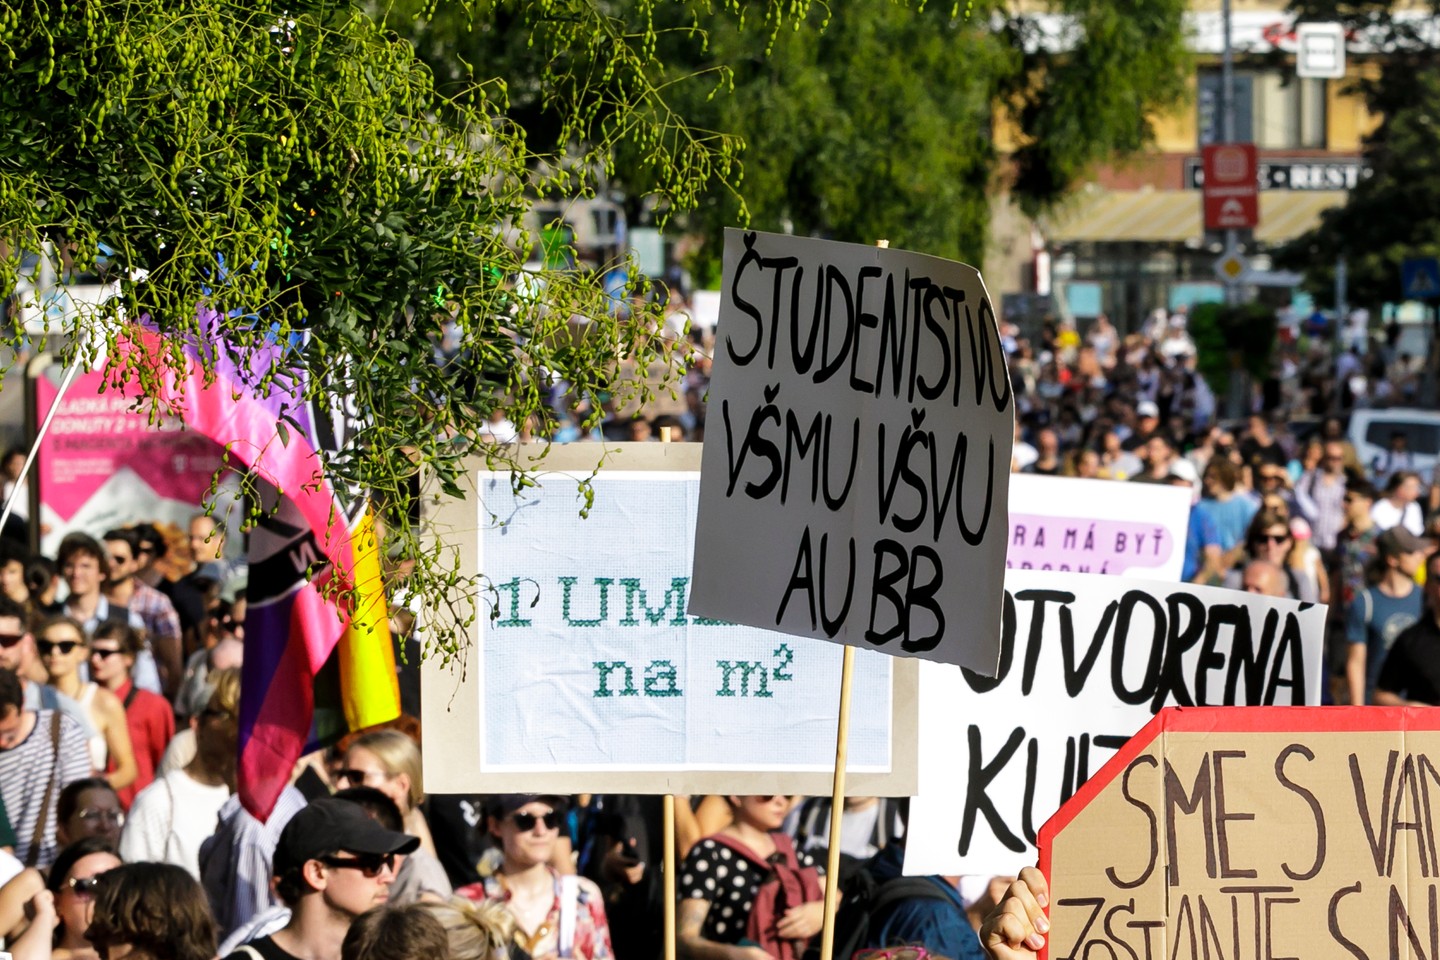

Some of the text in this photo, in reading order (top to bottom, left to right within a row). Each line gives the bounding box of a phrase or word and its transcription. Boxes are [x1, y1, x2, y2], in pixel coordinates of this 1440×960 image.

[725, 231, 1010, 413] ŠTUDENTSTVO
[722, 383, 995, 546] VŠMU VŠVU
[558, 576, 740, 628] UM
[775, 525, 946, 653] AU BB
[1013, 523, 1164, 556] RA MÁ BYŤ
[593, 660, 684, 698] na
[1105, 750, 1258, 889] SME
[1275, 743, 1327, 881] S
